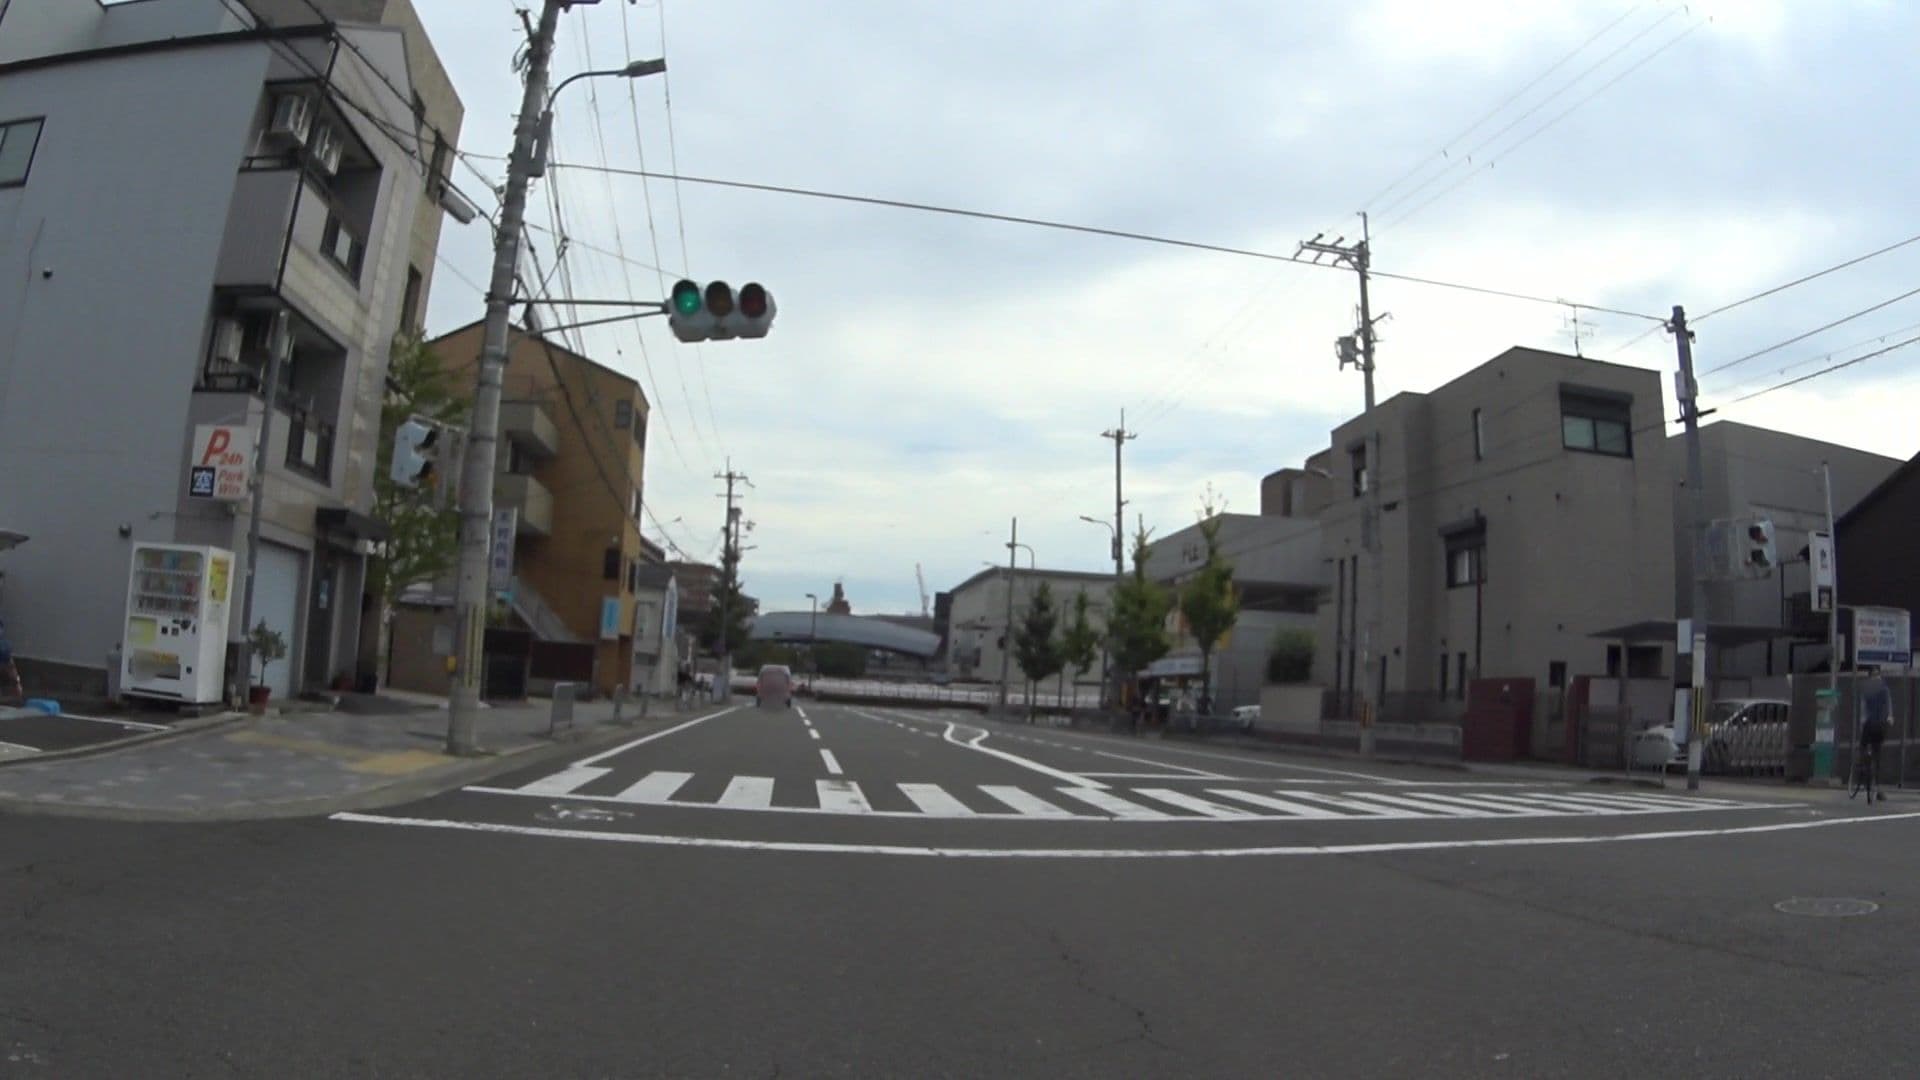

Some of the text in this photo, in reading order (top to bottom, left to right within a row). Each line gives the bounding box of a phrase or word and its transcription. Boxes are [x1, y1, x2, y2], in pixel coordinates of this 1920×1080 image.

[202, 428, 244, 466] P 24h
[217, 470, 244, 482] Park
